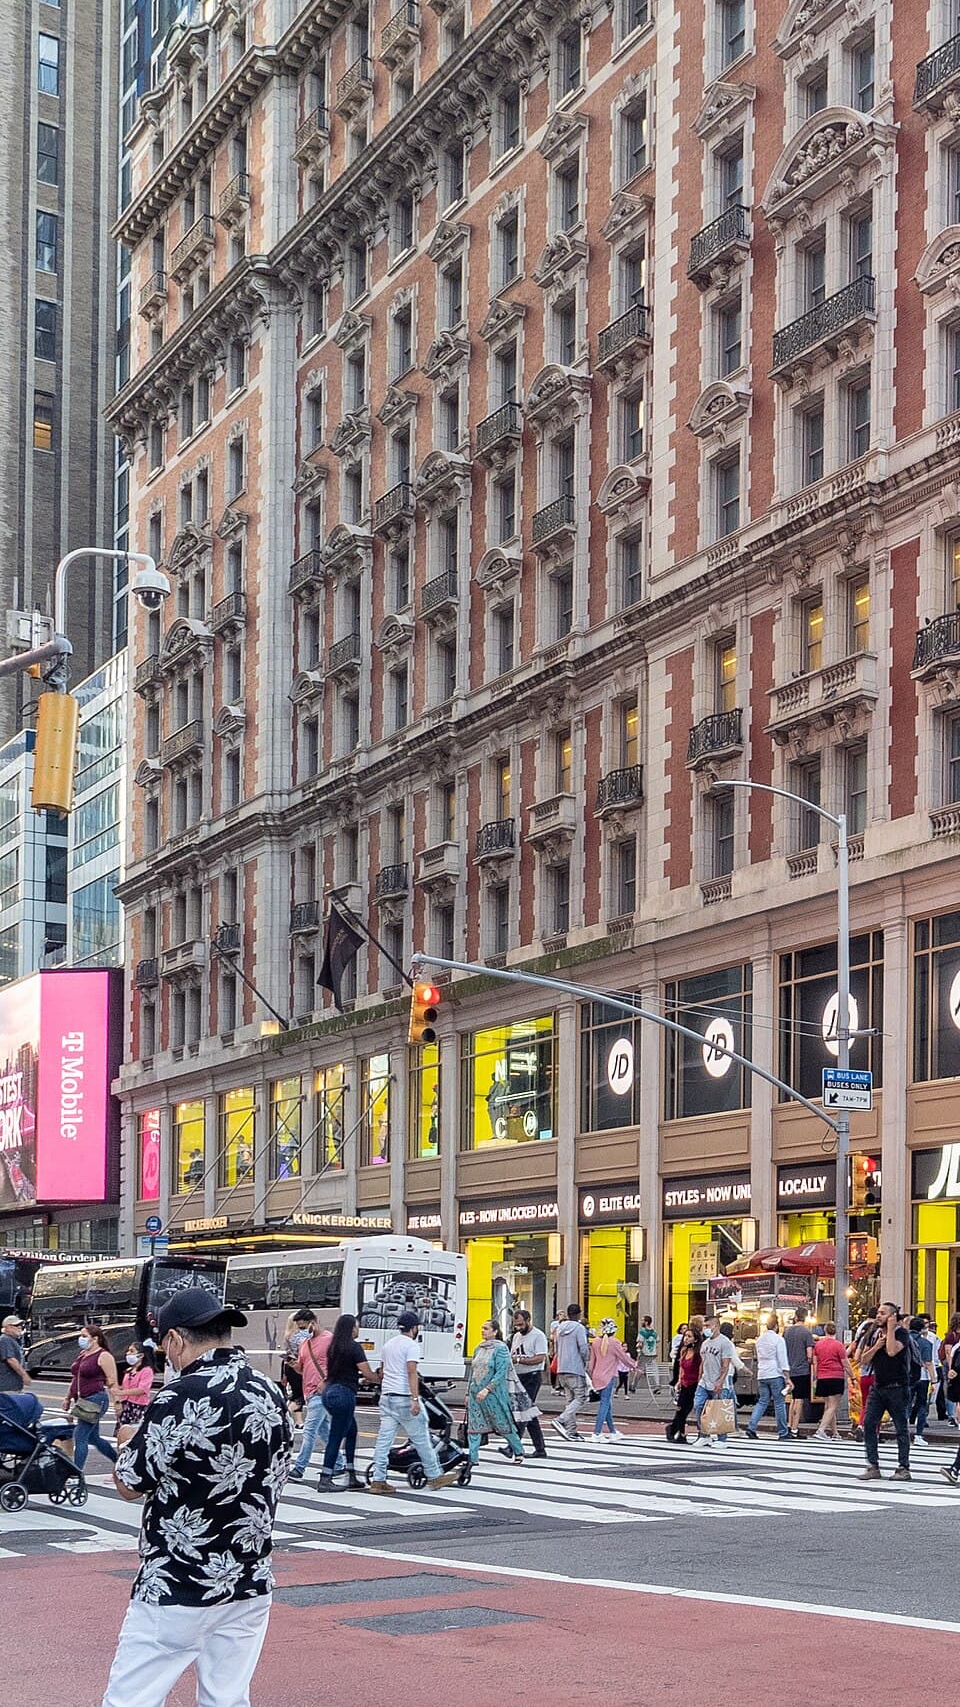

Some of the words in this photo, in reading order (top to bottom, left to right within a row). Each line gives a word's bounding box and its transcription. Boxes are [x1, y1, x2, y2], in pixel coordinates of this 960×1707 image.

[708, 1034, 727, 1060] JD
[611, 1053, 629, 1077] JD
[826, 1081, 849, 1089] BUSES
[850, 1082, 868, 1090] ONLY
[836, 1072, 849, 1080] BUS
[851, 1073, 869, 1081] LANE
[60, 1056, 84, 1139] Mobile
[779, 1175, 827, 1195] LOCALLY
[600, 1197, 622, 1212] ELITE
[665, 1191, 699, 1207] STYLES
[707, 1186, 731, 1204] NOW
[292, 1213, 392, 1229] KNICKERBOCKER
[480, 1208, 498, 1223] NOW
[498, 1204, 538, 1221] UNLOCKED
[58, 1252, 96, 1262] Garden
[98, 1253, 117, 1262] Inn
